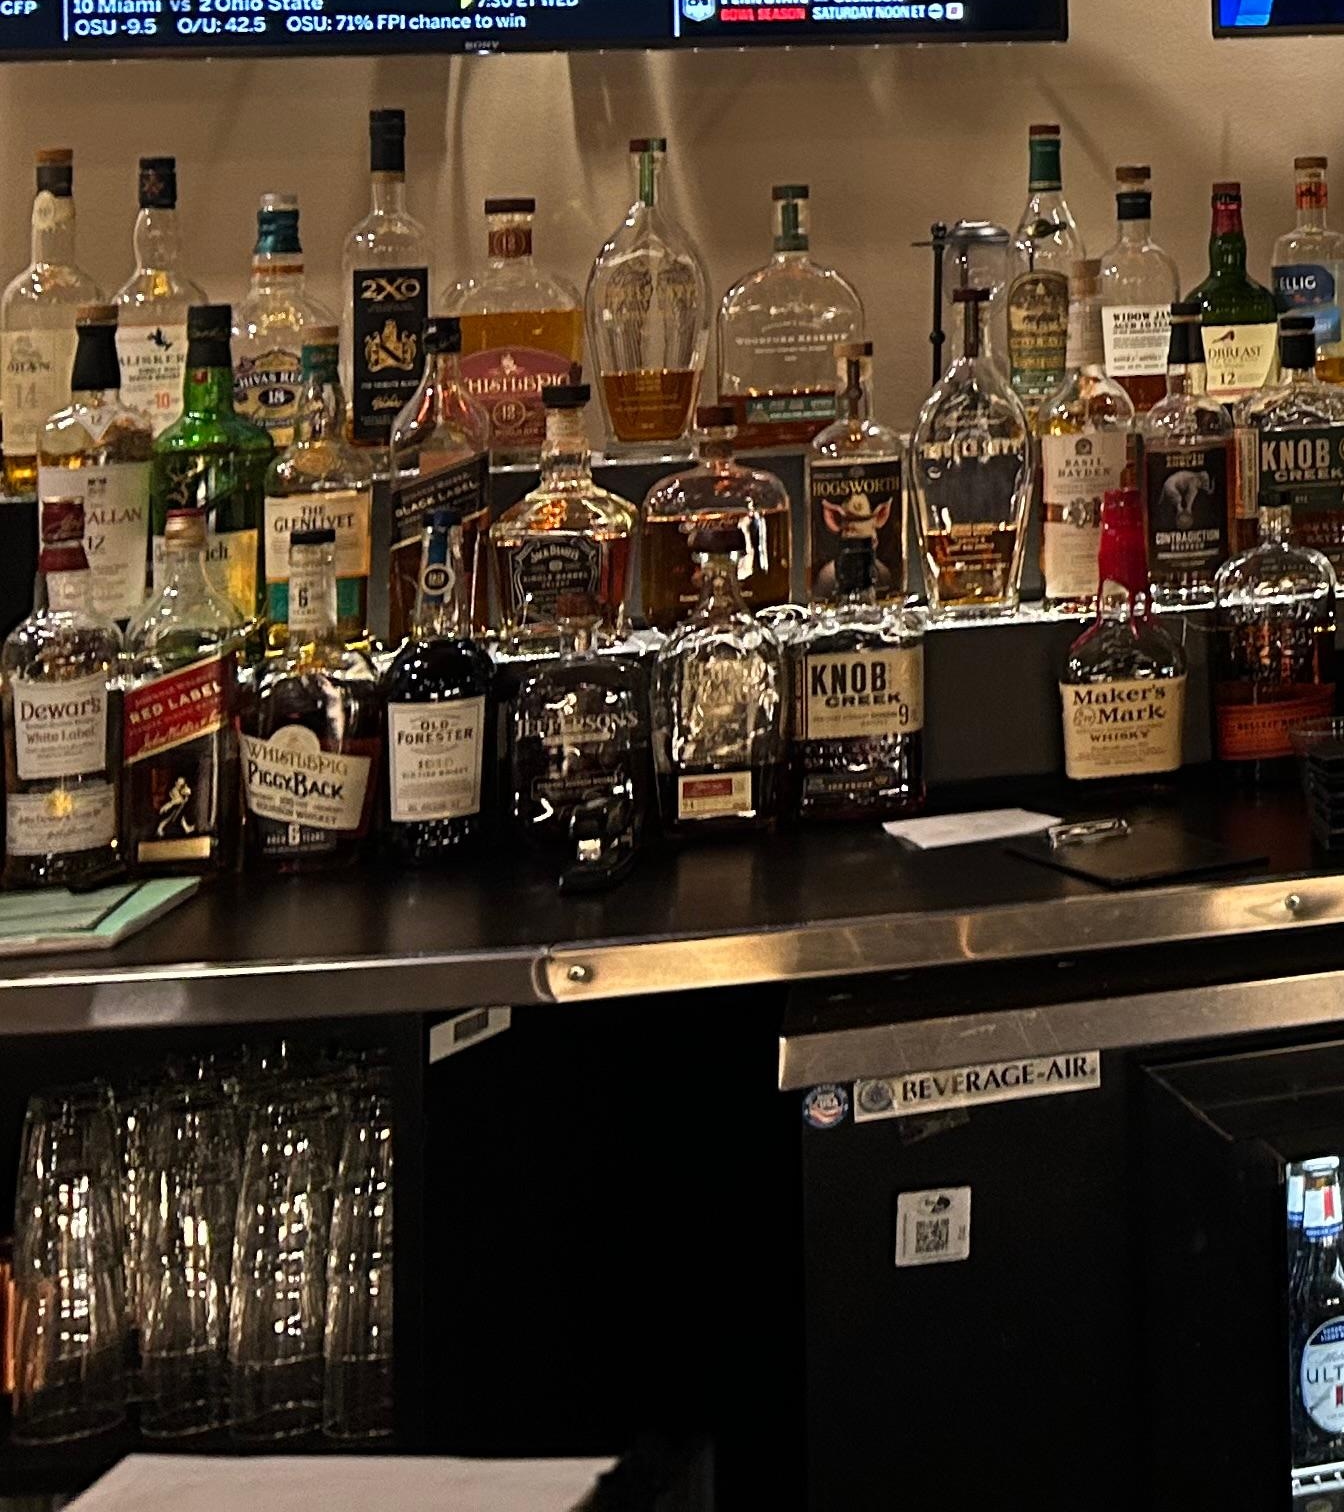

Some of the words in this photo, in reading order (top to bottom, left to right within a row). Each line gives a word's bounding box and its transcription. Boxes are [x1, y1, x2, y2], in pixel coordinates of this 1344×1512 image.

[170, 0, 191, 12] vs
[75, 19, 115, 36] OSU
[120, 18, 157, 35] -9.5
[178, 18, 222, 35] O/U:
[225, 17, 266, 34] 42.5
[286, 16, 332, 32] OSU:
[337, 15, 374, 31] 71%
[376, 15, 405, 31] FPI
[408, 15, 471, 30] chance
[475, 15, 493, 30] to
[496, 14, 525, 29] win
[361, 277, 420, 302] 2XO
[1262, 438, 1330, 472] KNOB
[1274, 467, 1344, 483] CREEK
[395, 494, 431, 517] BLACK
[436, 480, 476, 500] LABEL
[300, 504, 326, 517] THE
[274, 511, 356, 533] GLENLIVET
[811, 661, 887, 696] KNOB
[130, 705, 163, 724] RED
[168, 680, 222, 711] LABEL
[824, 692, 902, 709] CREEK
[1073, 687, 1166, 707] Maker's
[1098, 706, 1165, 723] Mark
[27, 731, 60, 744] White
[61, 727, 96, 740] Label
[420, 720, 448, 733] OLD
[396, 727, 474, 746] FORESTER
[1090, 730, 1149, 743] WHISKY
